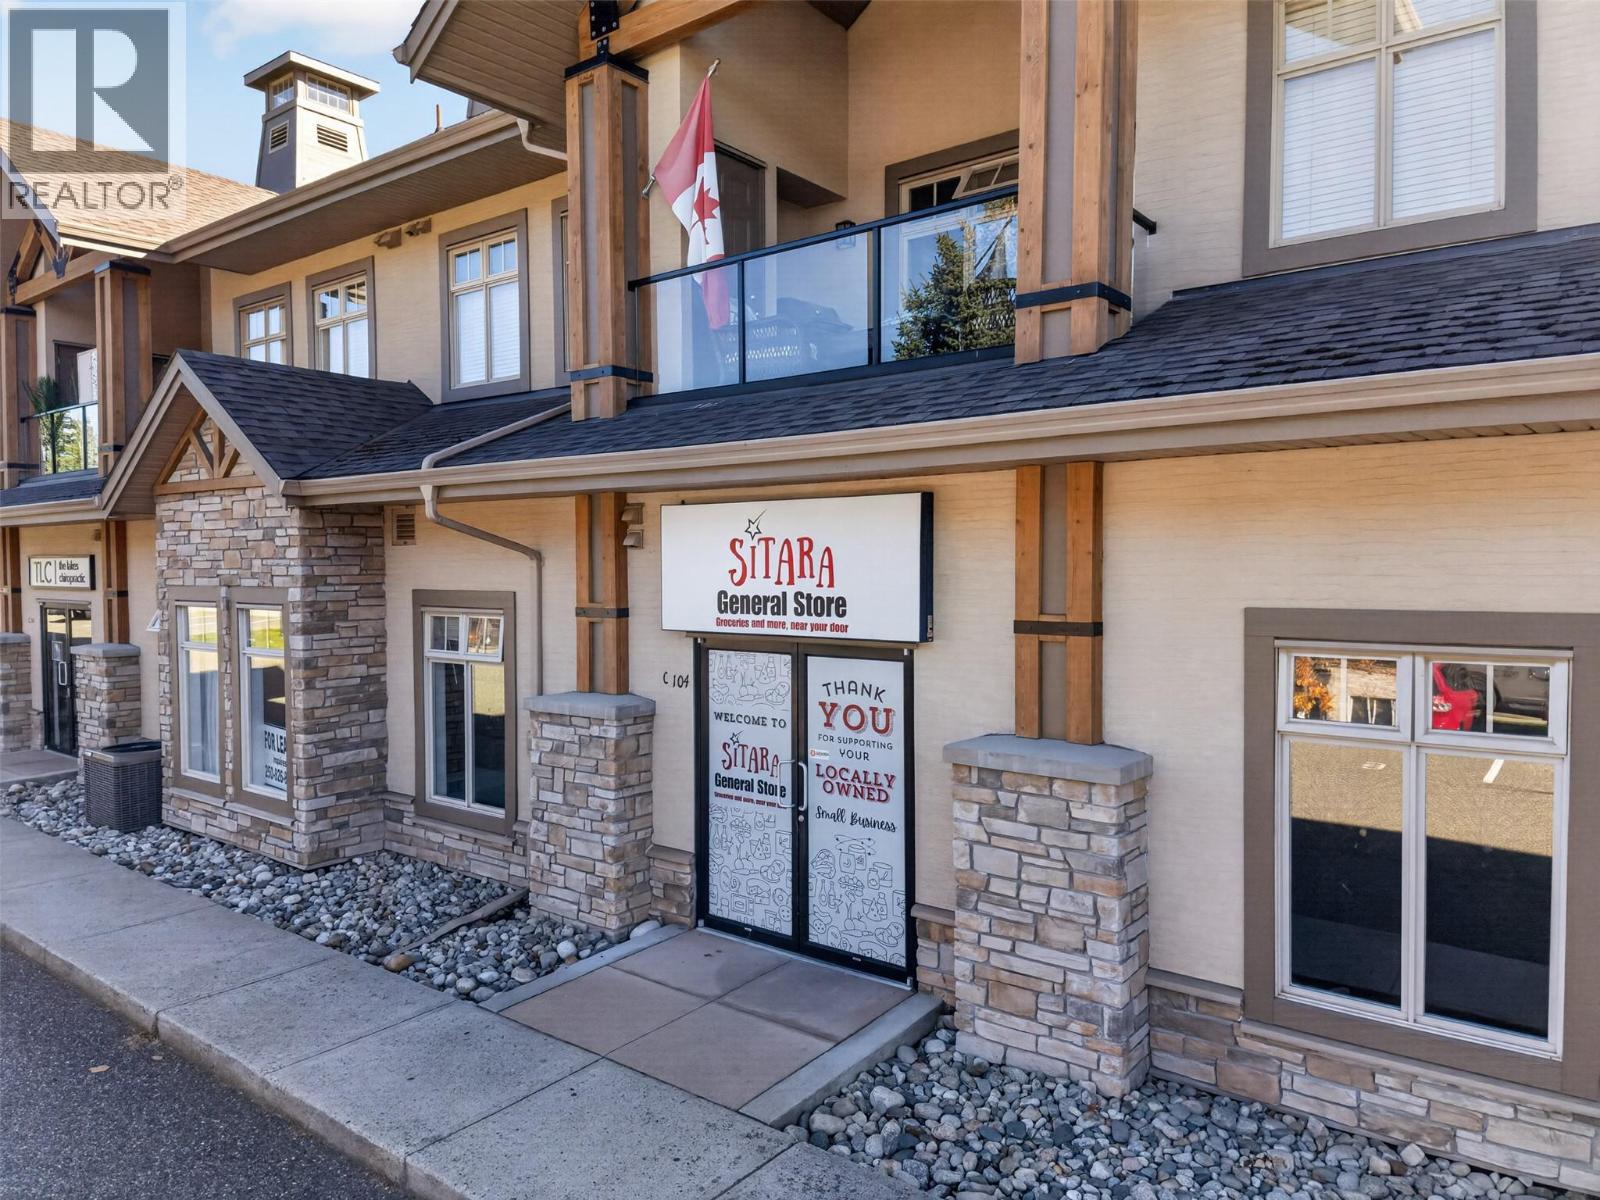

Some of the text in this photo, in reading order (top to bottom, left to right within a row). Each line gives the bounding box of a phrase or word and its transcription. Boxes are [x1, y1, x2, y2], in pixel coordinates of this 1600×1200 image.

[34, 560, 53, 584] TLC
[717, 589, 847, 619] General Store
[716, 617, 849, 633] Groceries and more, near your door
[662, 671, 690, 689] C 104
[822, 680, 886, 704] THANK
[713, 711, 787, 729] WELCOME TO
[818, 701, 896, 738] YOU
[264, 730, 276, 751] FOR
[818, 733, 894, 750] FOR SUPPORTING
[839, 748, 870, 761] YOUR
[714, 772, 755, 793] General
[815, 763, 897, 790] LOCALLY
[822, 779, 891, 804] OWNED
[815, 805, 898, 833] Small Business
